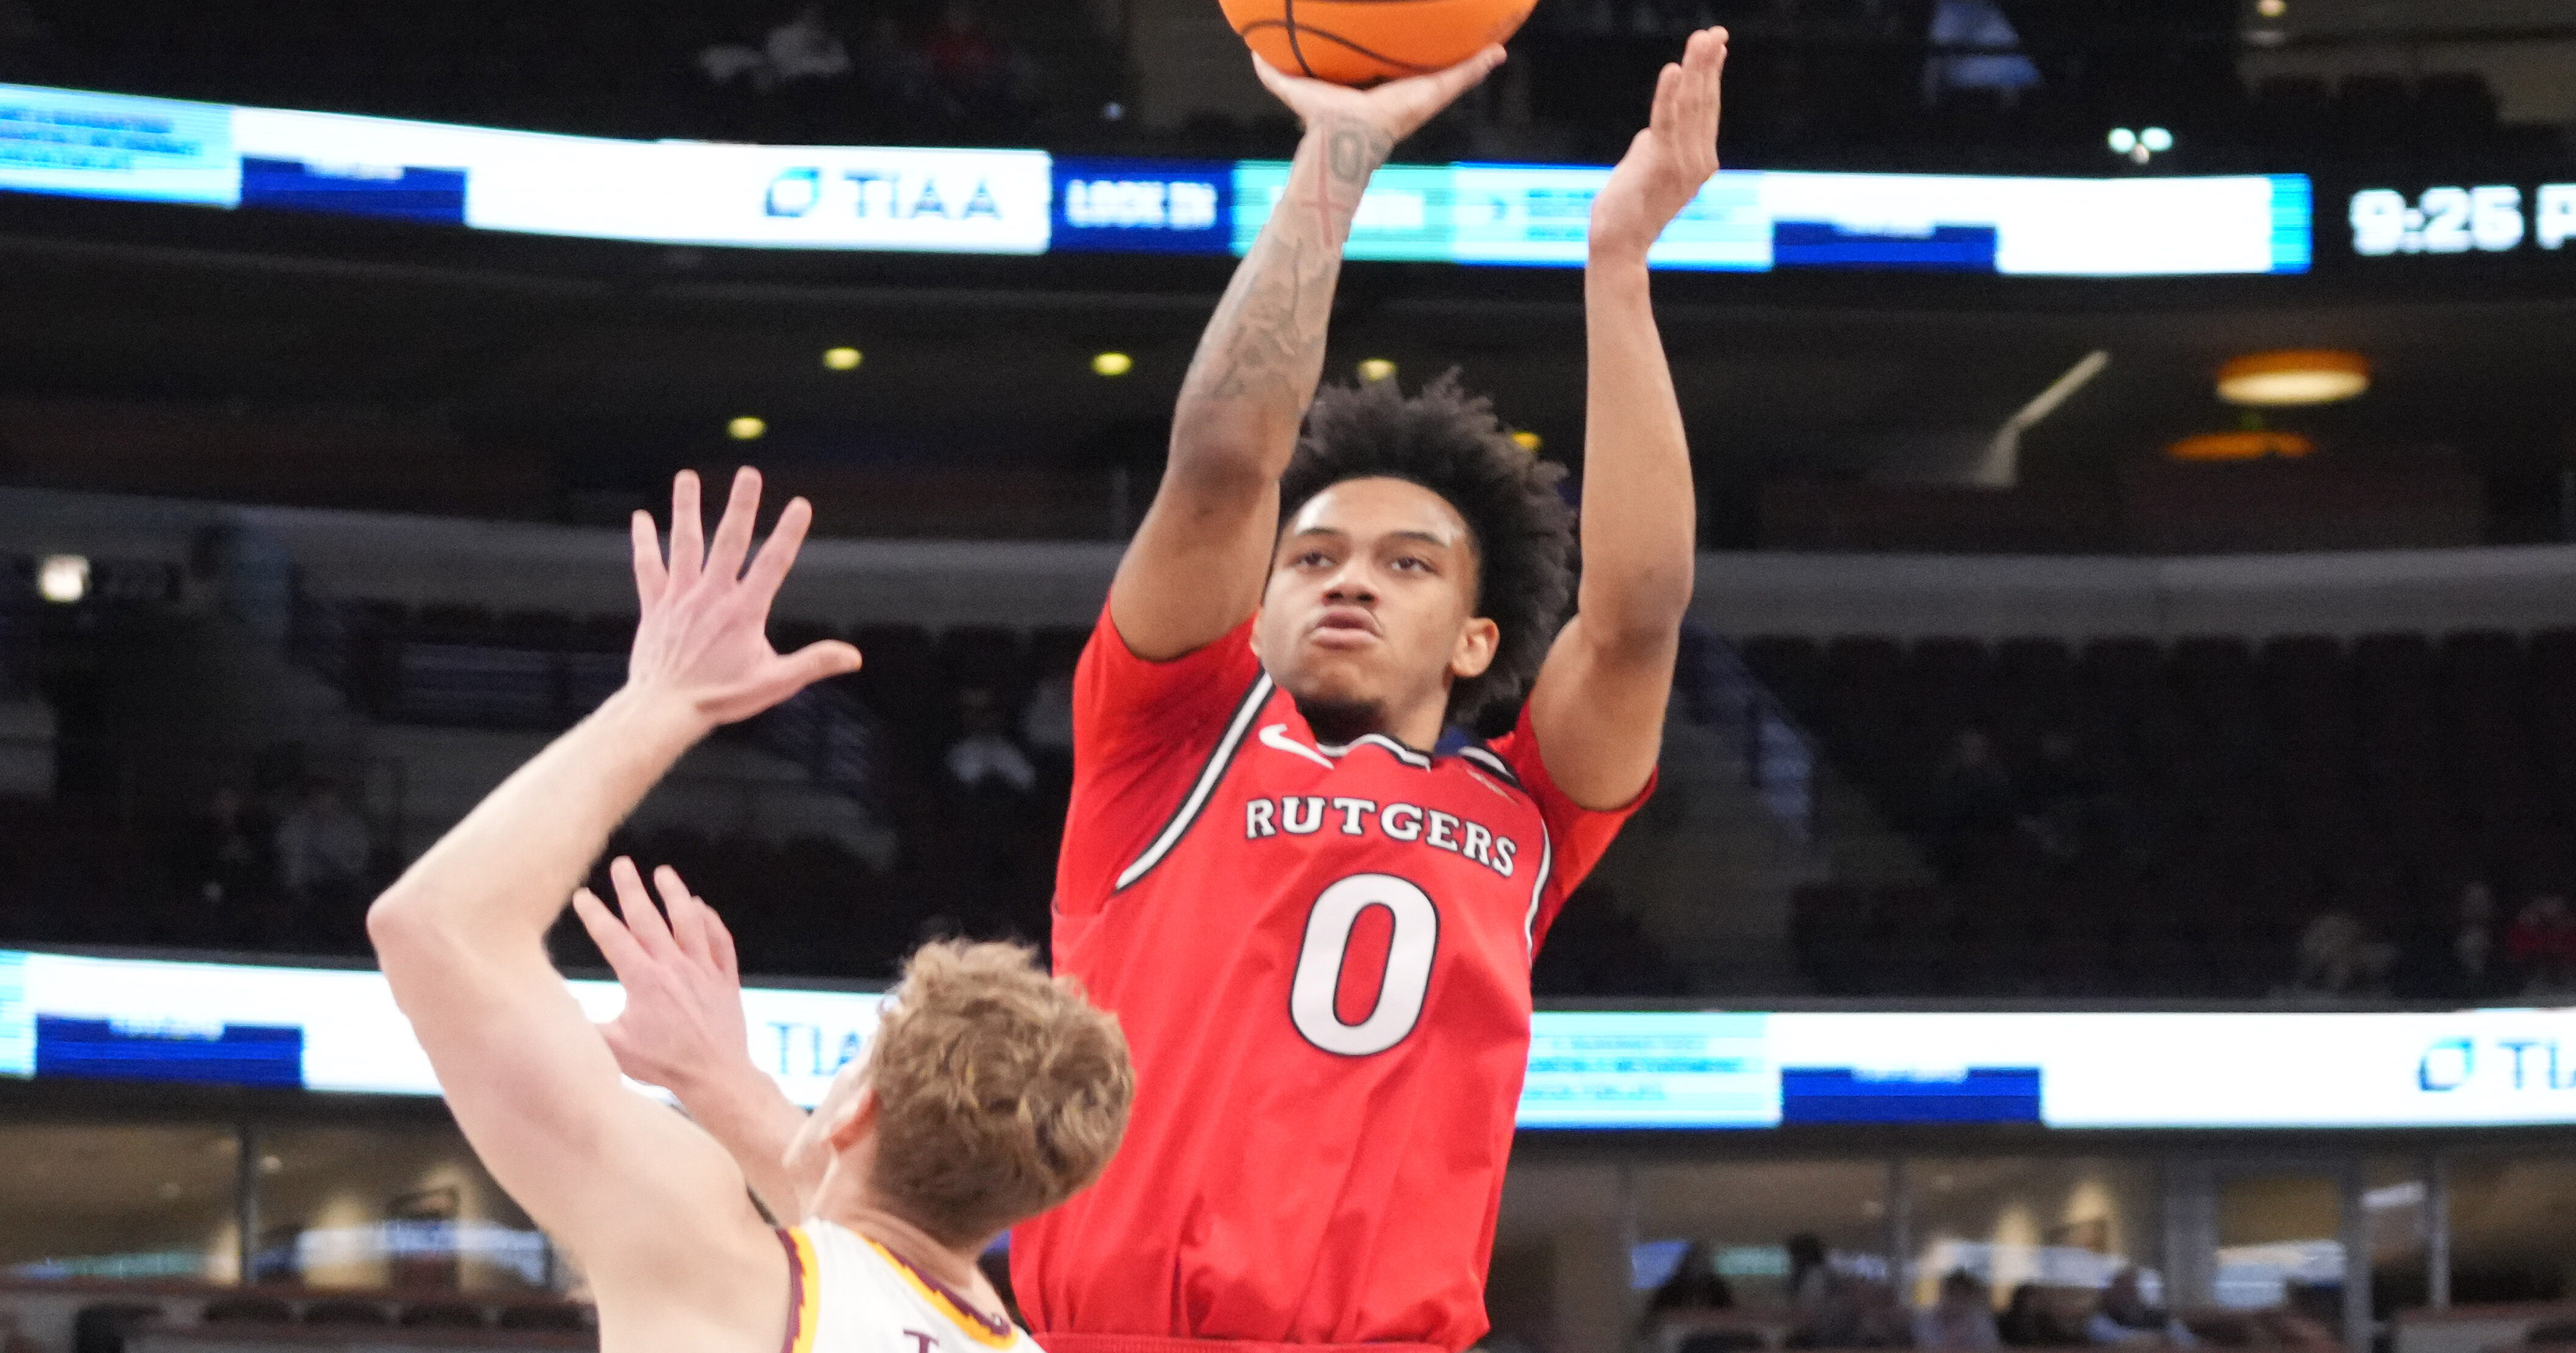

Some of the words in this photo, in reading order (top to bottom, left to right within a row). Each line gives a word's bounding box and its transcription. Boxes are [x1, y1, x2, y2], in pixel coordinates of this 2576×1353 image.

[843, 172, 1003, 221] TIAA
[1244, 795, 1519, 878] RUTGERS
[1288, 872, 1440, 1057] 0
